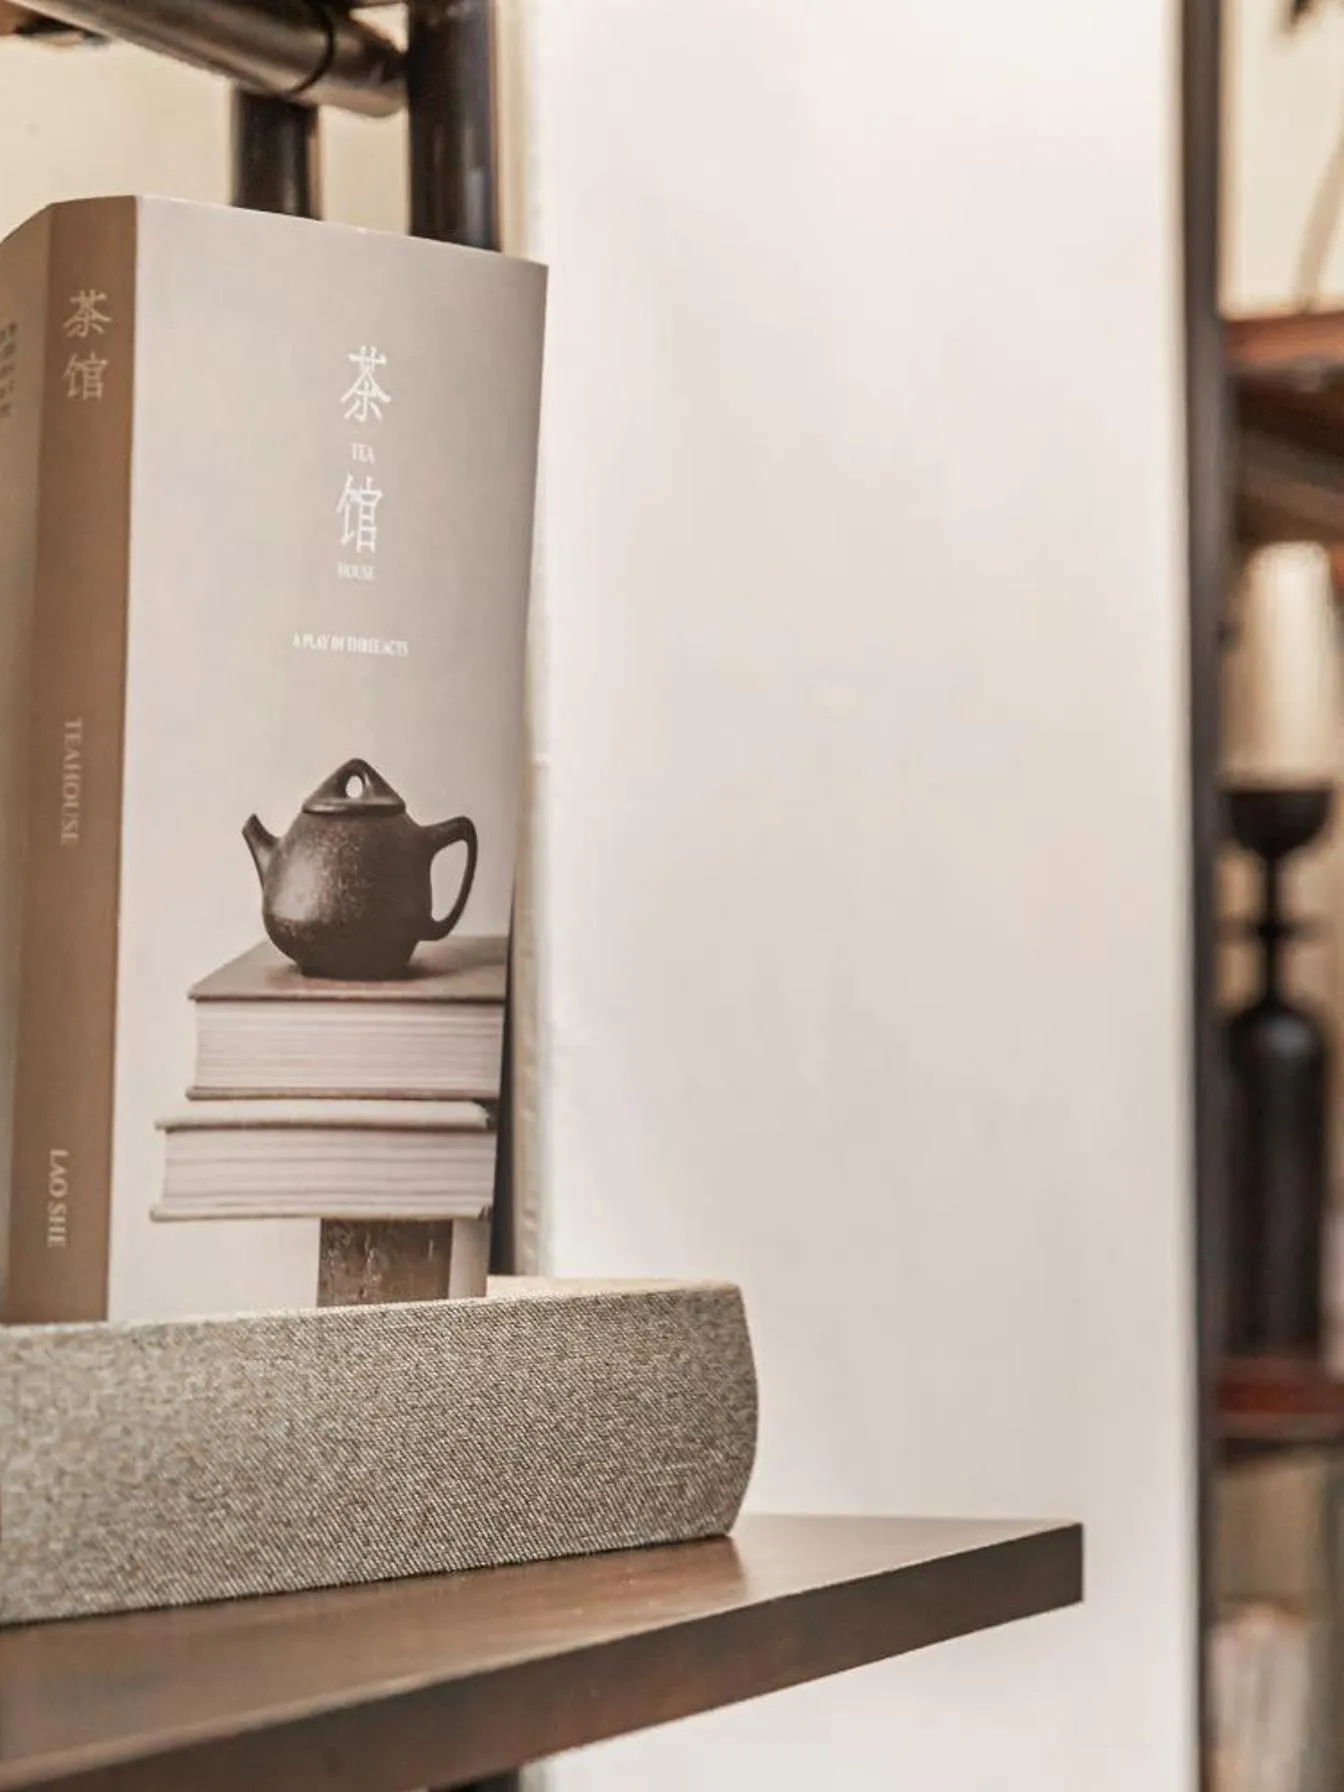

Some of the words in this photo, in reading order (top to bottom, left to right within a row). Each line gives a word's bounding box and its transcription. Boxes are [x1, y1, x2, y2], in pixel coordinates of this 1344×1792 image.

[62, 288, 112, 401] 茶馆
[340, 346, 391, 422] 茶
[351, 443, 375, 464] TEA
[337, 474, 383, 553] 馆
[338, 561, 376, 582] HOUSE
[60, 717, 83, 846] TEAHOUSE
[48, 1148, 69, 1198] LAO
[47, 1201, 67, 1248] SHE
